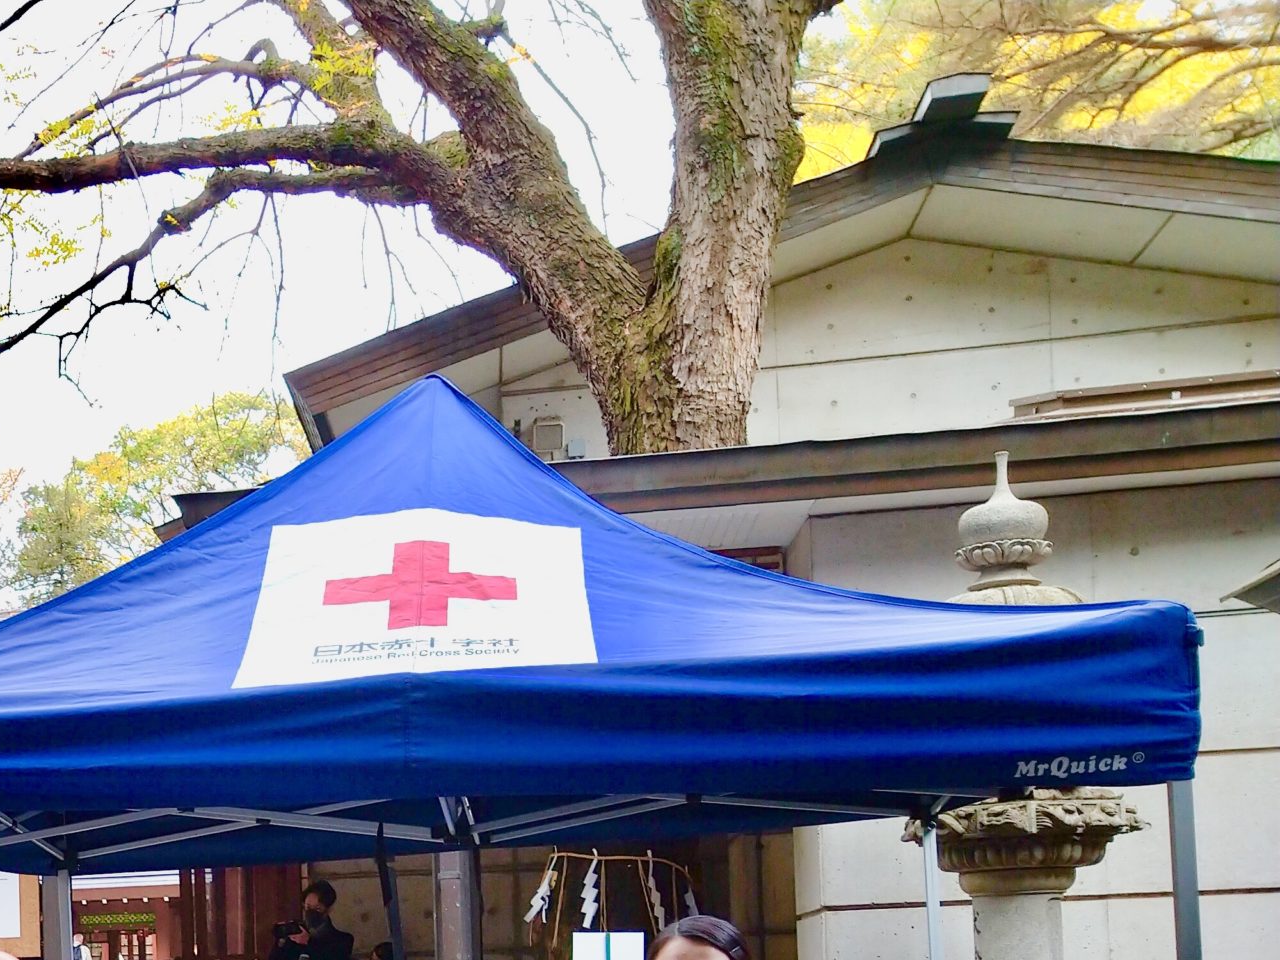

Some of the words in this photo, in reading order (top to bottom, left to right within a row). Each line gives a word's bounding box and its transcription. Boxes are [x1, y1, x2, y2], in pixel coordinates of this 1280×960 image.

[311, 654, 383, 665] Japanese
[387, 651, 416, 660] Red
[419, 649, 461, 658] Cross
[464, 647, 520, 656] Society
[312, 636, 520, 658] 日本赤十字社
